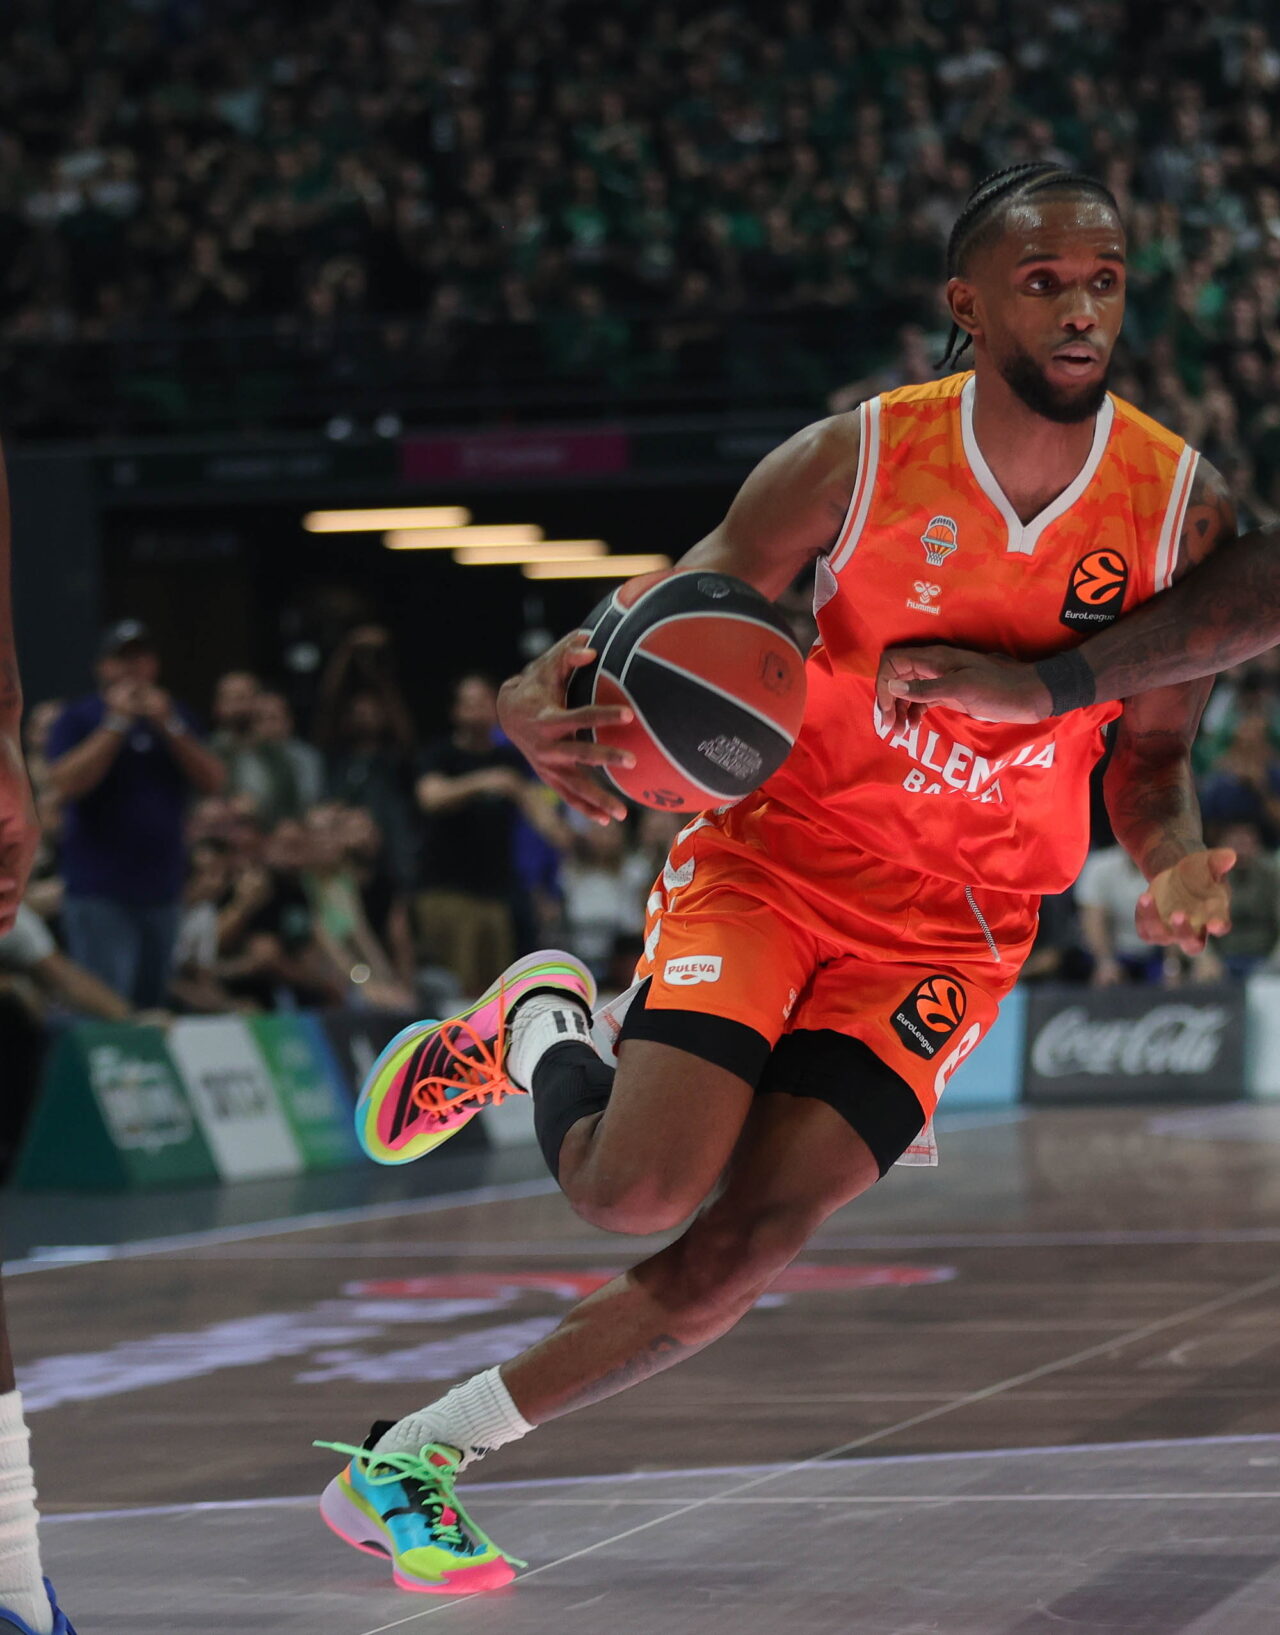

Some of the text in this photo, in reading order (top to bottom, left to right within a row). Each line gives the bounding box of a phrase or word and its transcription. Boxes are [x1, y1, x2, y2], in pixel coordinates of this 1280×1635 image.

[906, 599, 941, 615] hummel
[1064, 610, 1116, 623] EuroLeague
[873, 695, 1056, 793] VALENIA
[668, 963, 716, 975] PULEVA
[896, 1012, 935, 1055] EuroLeague
